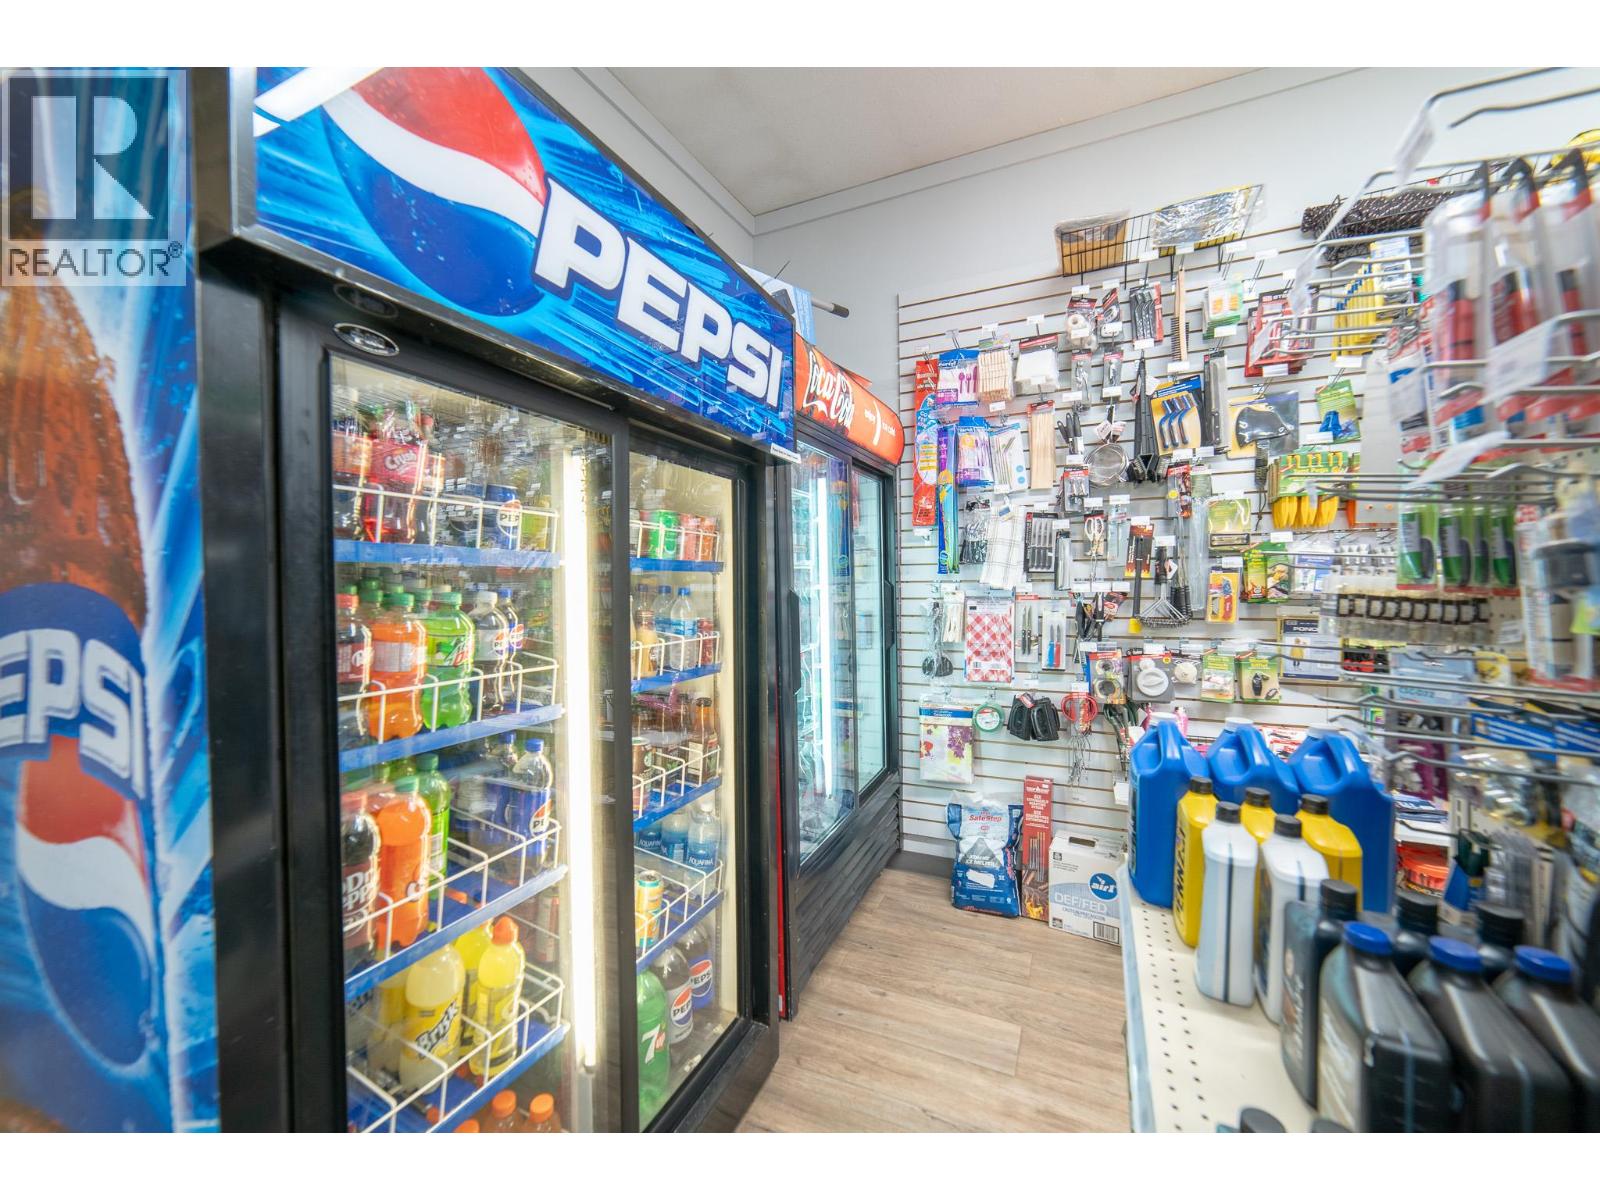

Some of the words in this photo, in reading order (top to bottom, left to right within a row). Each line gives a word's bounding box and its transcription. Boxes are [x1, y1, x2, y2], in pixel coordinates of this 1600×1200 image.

[533, 177, 784, 409] PEPSI
[0, 629, 146, 801] EPSI
[414, 999, 461, 1059] Brisk
